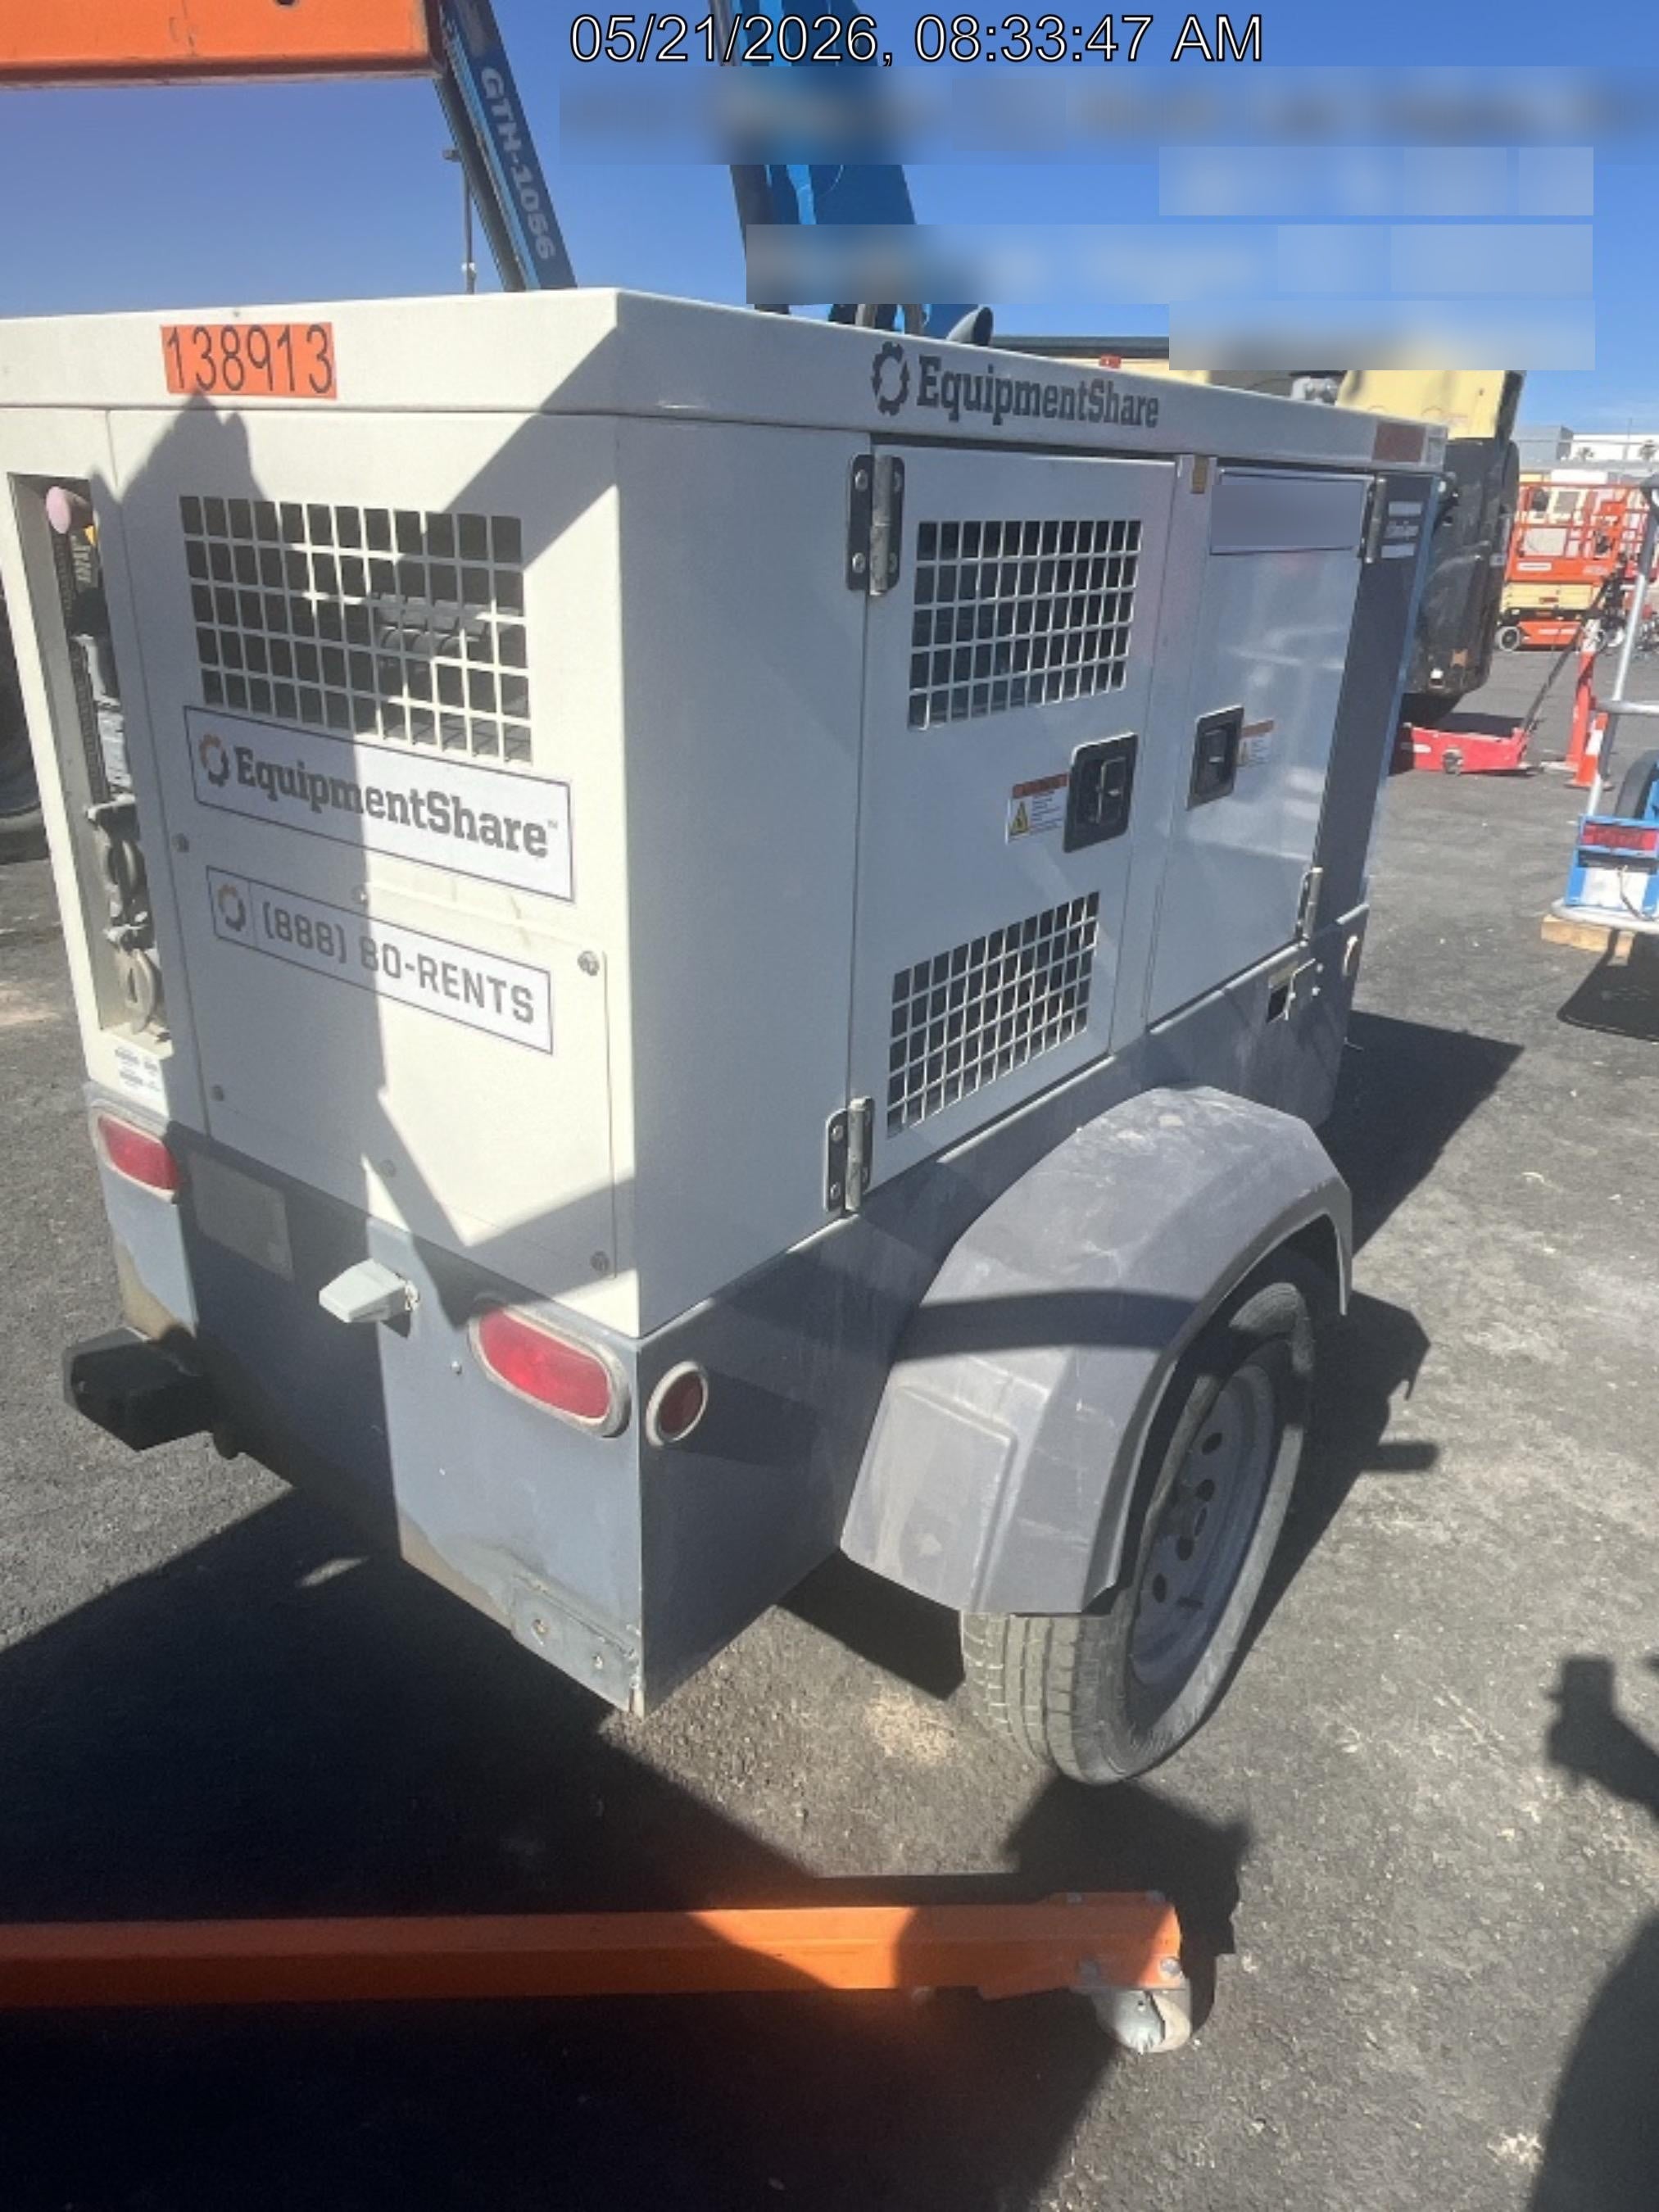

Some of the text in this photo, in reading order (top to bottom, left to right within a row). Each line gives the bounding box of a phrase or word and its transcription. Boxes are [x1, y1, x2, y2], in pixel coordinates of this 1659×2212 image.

[481, 66, 557, 260] GTH-1056
[166, 324, 333, 393] 138913
[917, 355, 1159, 428] EquipmentShare
[233, 746, 548, 859] EquipmentShare
[262, 901, 347, 964] (888)
